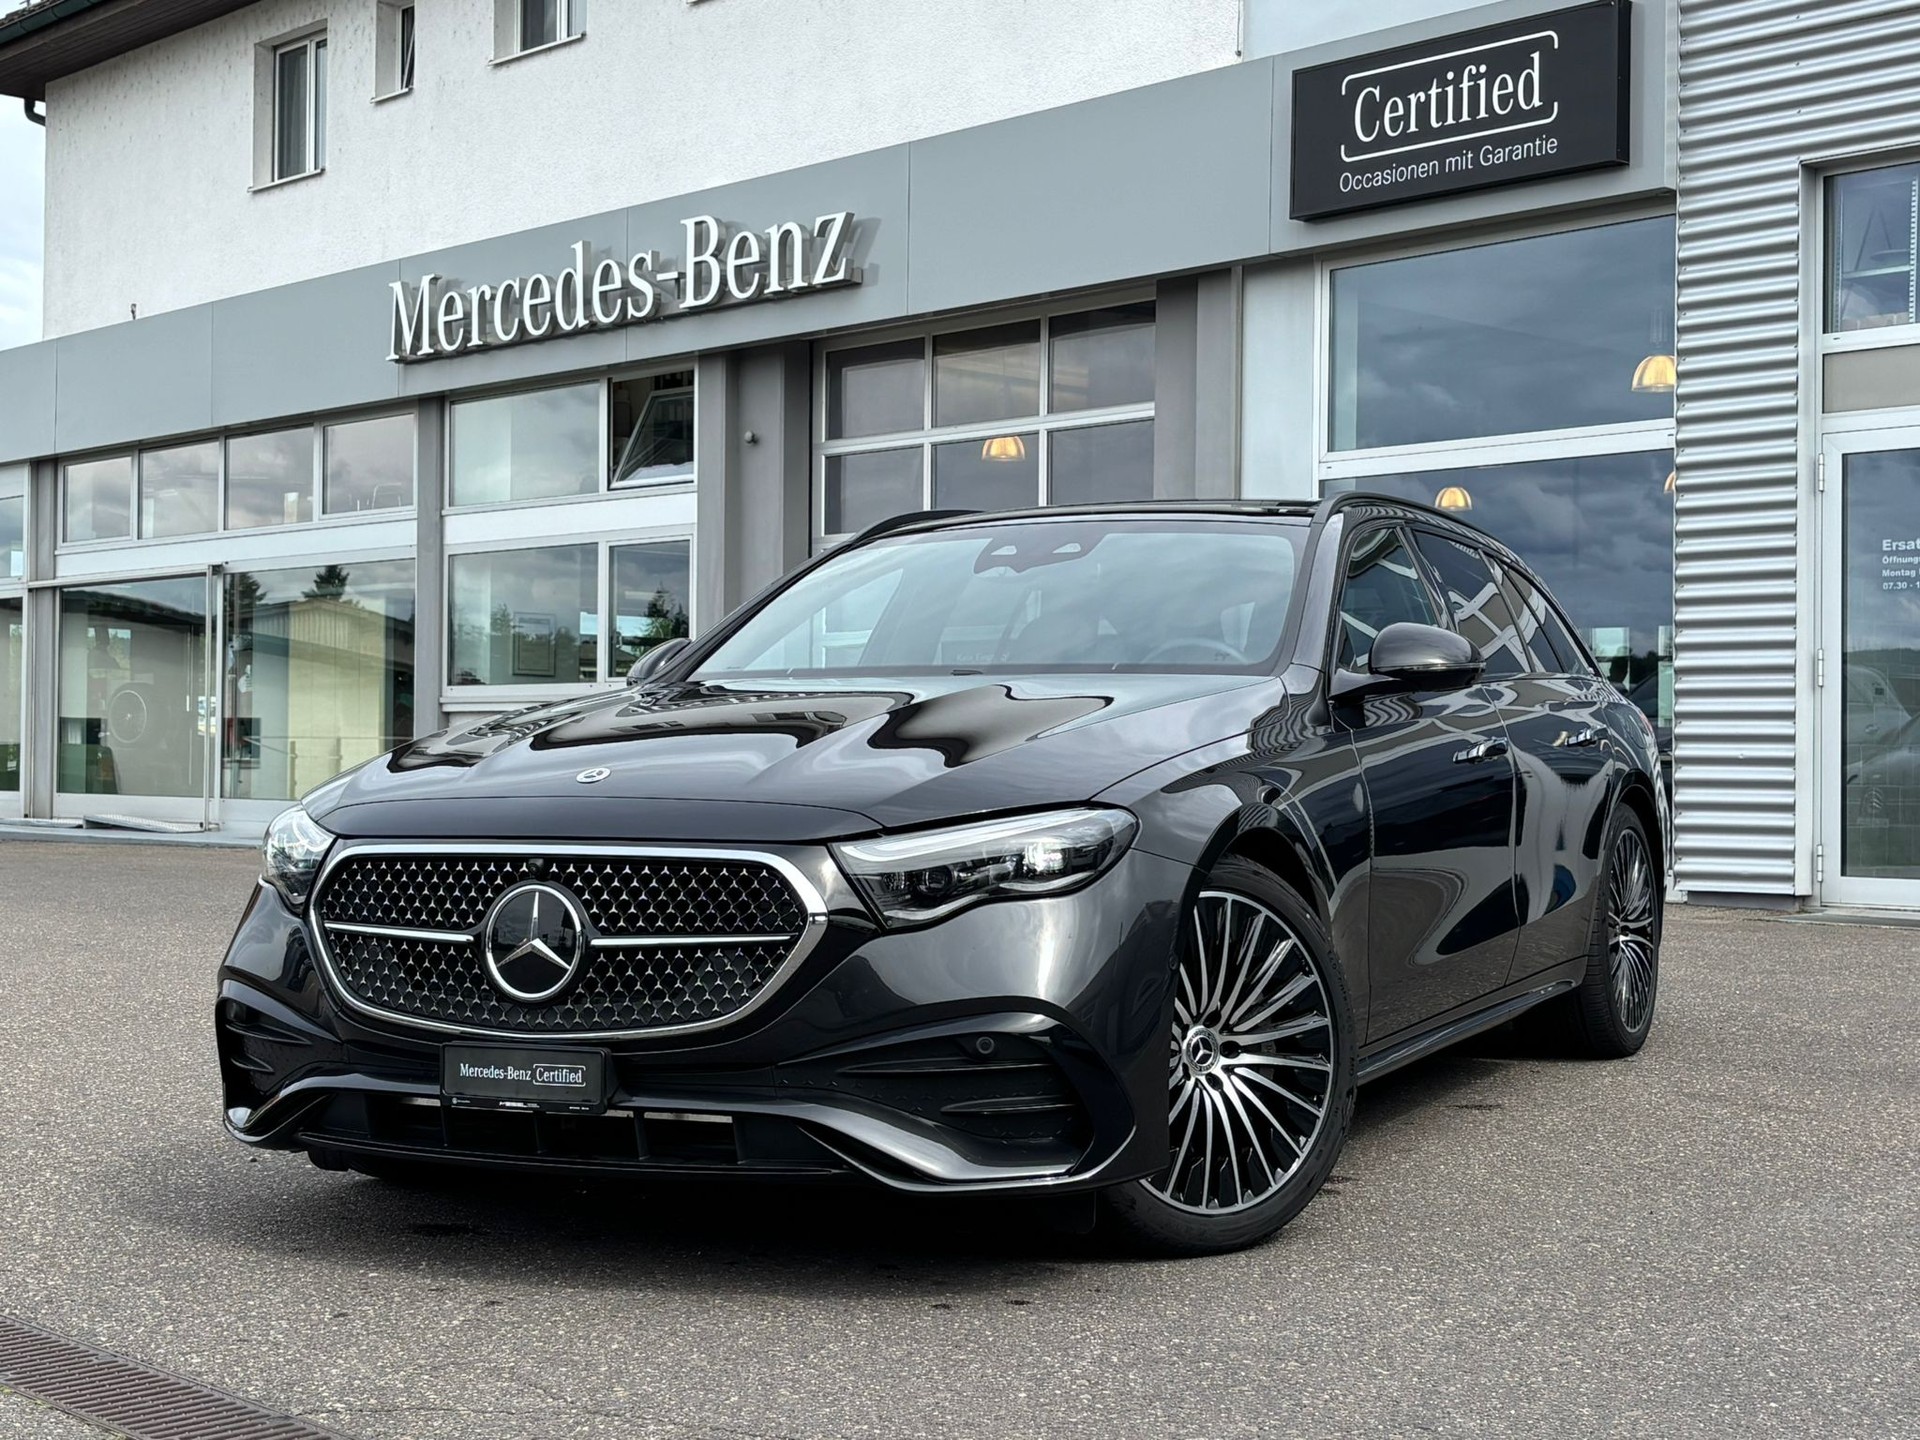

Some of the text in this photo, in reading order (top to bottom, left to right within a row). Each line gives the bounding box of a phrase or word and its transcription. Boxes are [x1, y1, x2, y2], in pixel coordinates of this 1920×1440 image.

[1354, 50, 1543, 143] Certified
[1339, 134, 1558, 192] Occasionen mit Garantie
[385, 211, 857, 362] Mercedes-Benz
[1882, 569, 1916, 578] Montag
[1883, 582, 1908, 590] 07.30
[459, 1063, 582, 1083] Mercedes-Benz Certified
